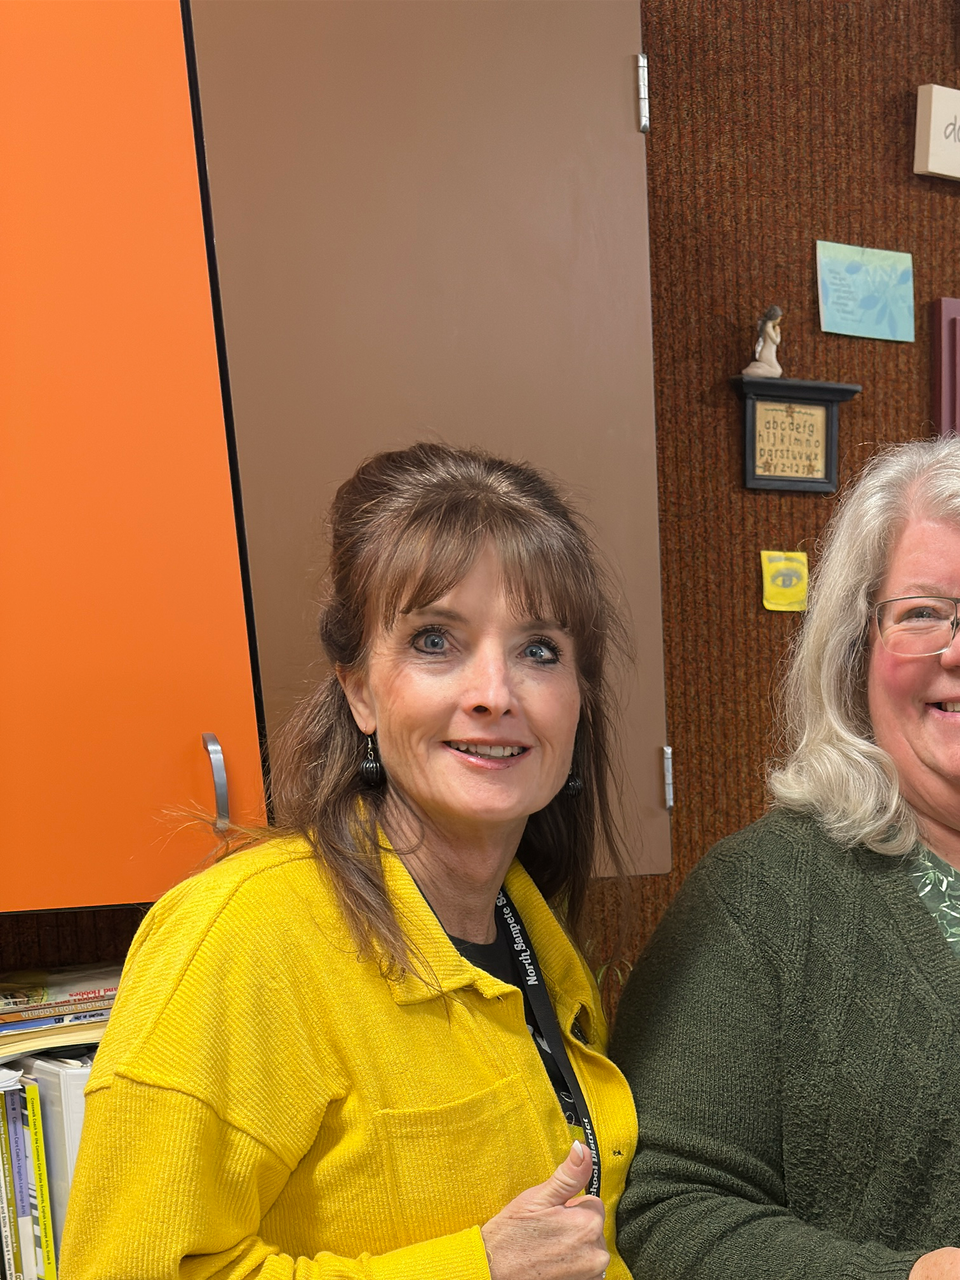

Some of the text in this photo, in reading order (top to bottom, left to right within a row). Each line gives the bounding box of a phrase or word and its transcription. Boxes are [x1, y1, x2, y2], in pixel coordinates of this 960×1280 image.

[503, 906, 526, 950] Sanpete
[519, 949, 538, 985] North
[21, 1008, 54, 1018] WEIRDOS
[56, 1005, 76, 1014] FROM
[77, 1000, 110, 1010] ANOTHER
[583, 1118, 598, 1162] District
